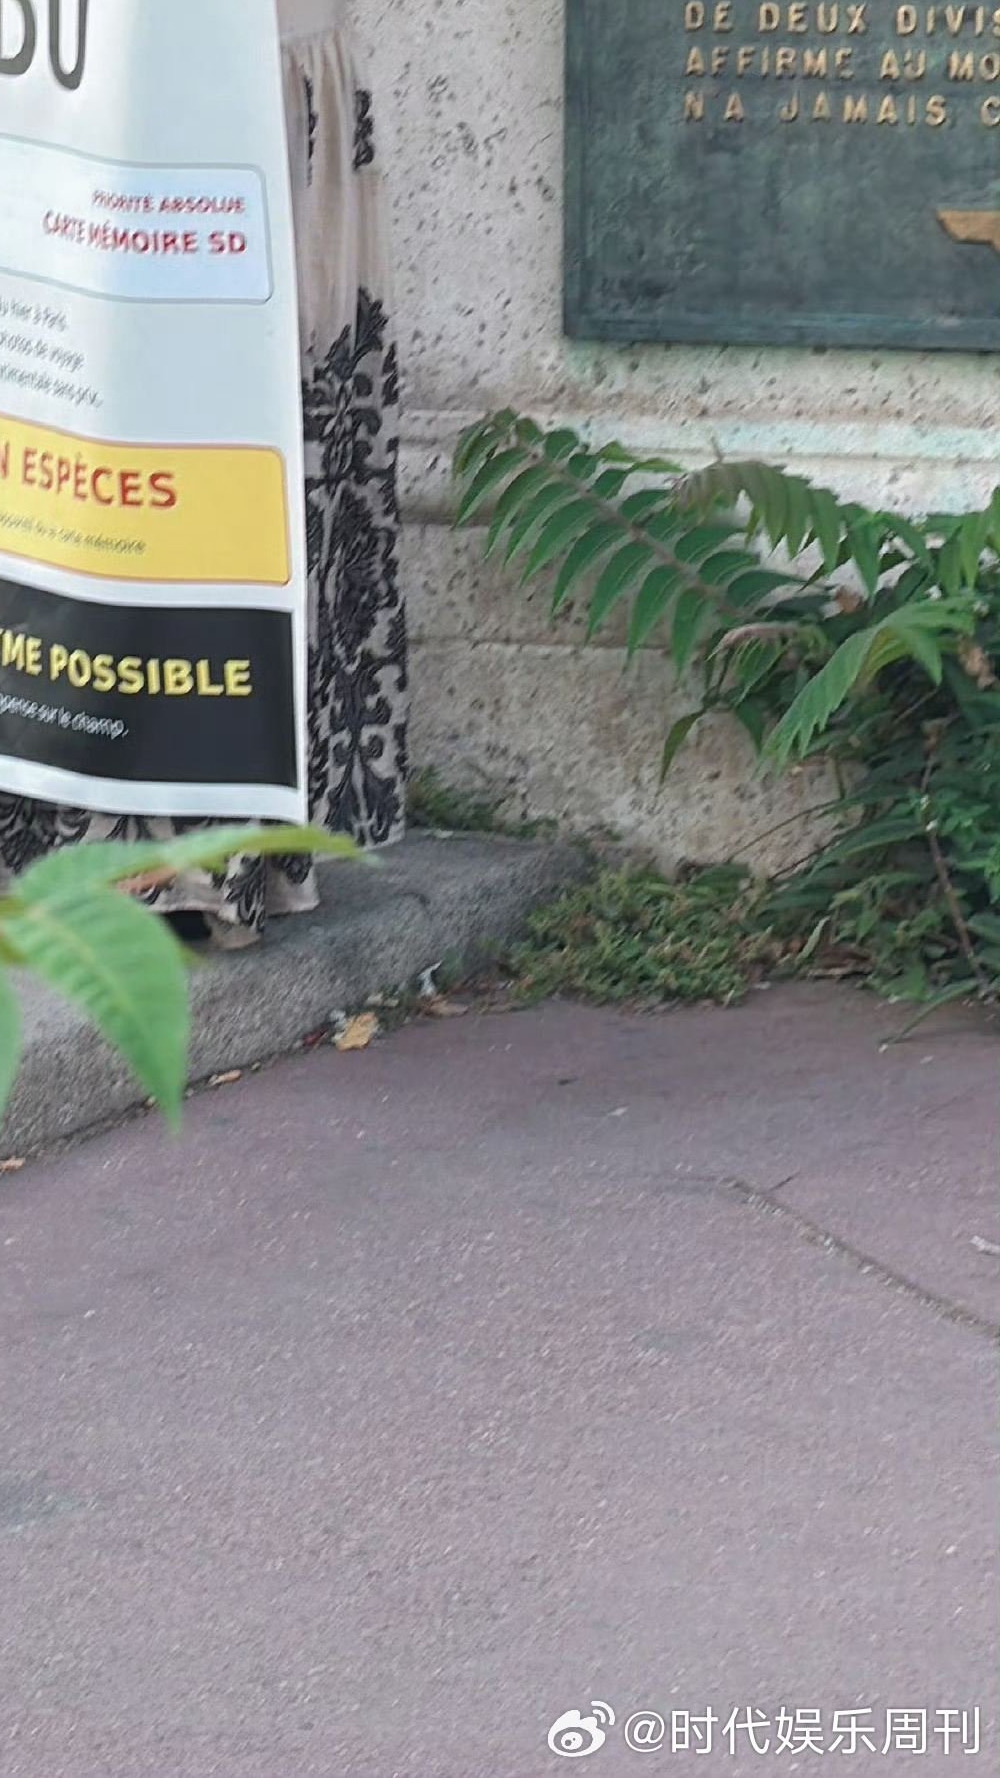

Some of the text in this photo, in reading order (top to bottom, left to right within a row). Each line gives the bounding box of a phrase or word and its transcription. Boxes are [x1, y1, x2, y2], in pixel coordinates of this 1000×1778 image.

[684, 0, 733, 33] DE
[758, 2, 867, 35] DEUX
[685, 45, 853, 79] AFFIRME
[880, 49, 926, 80] AU
[780, 92, 947, 126] JAMAIS
[159, 195, 246, 214] ABSOLUE
[42, 209, 248, 255] CARTE MÉMOIRE SD
[22, 447, 178, 508] ESPÈCES
[49, 643, 252, 696] POSSIBLE
